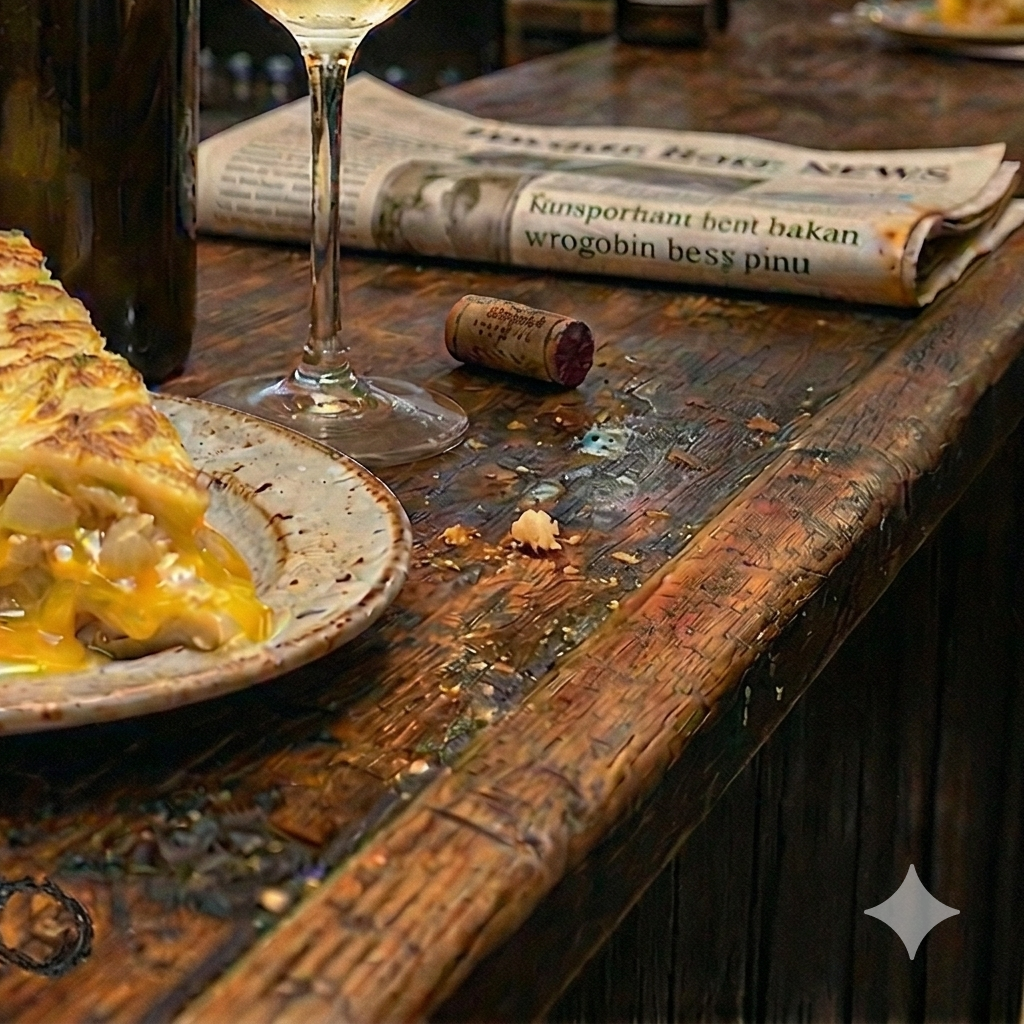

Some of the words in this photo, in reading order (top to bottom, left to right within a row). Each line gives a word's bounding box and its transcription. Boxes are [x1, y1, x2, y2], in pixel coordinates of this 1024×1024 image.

[769, 216, 859, 246] bakan
[525, 230, 656, 259] wrogobin
[744, 247, 811, 276] pinu
